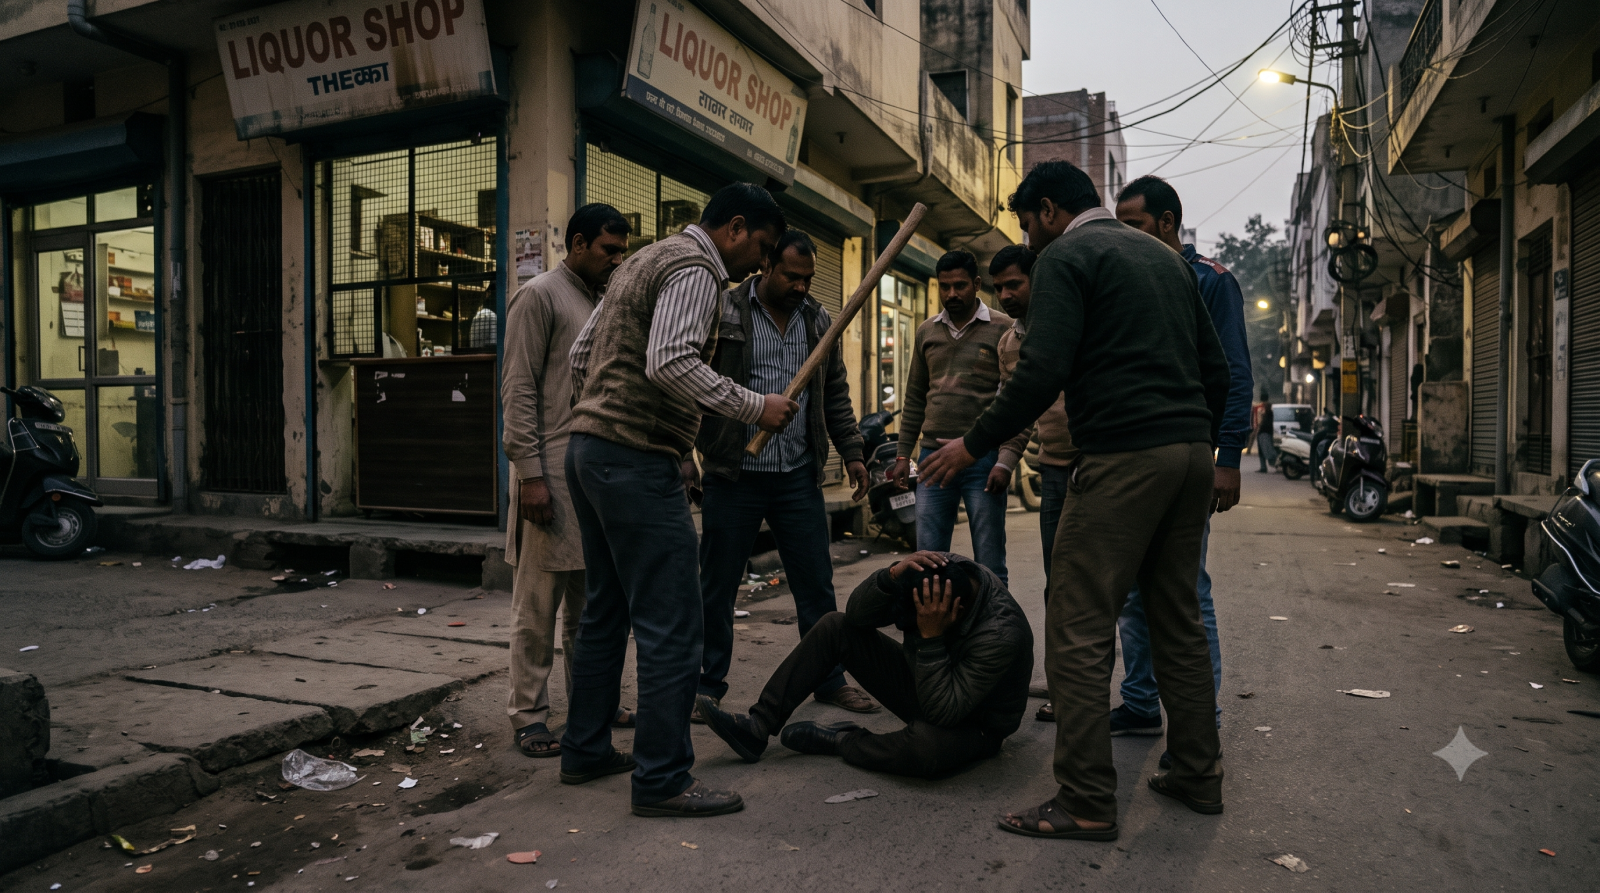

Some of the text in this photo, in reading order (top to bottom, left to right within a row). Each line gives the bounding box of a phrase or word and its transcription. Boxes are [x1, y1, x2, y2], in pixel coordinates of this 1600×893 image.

[227, 0, 465, 80] LIQUOR SHOP
[659, 12, 742, 101] LIQUOR
[745, 73, 792, 130] SHOP
